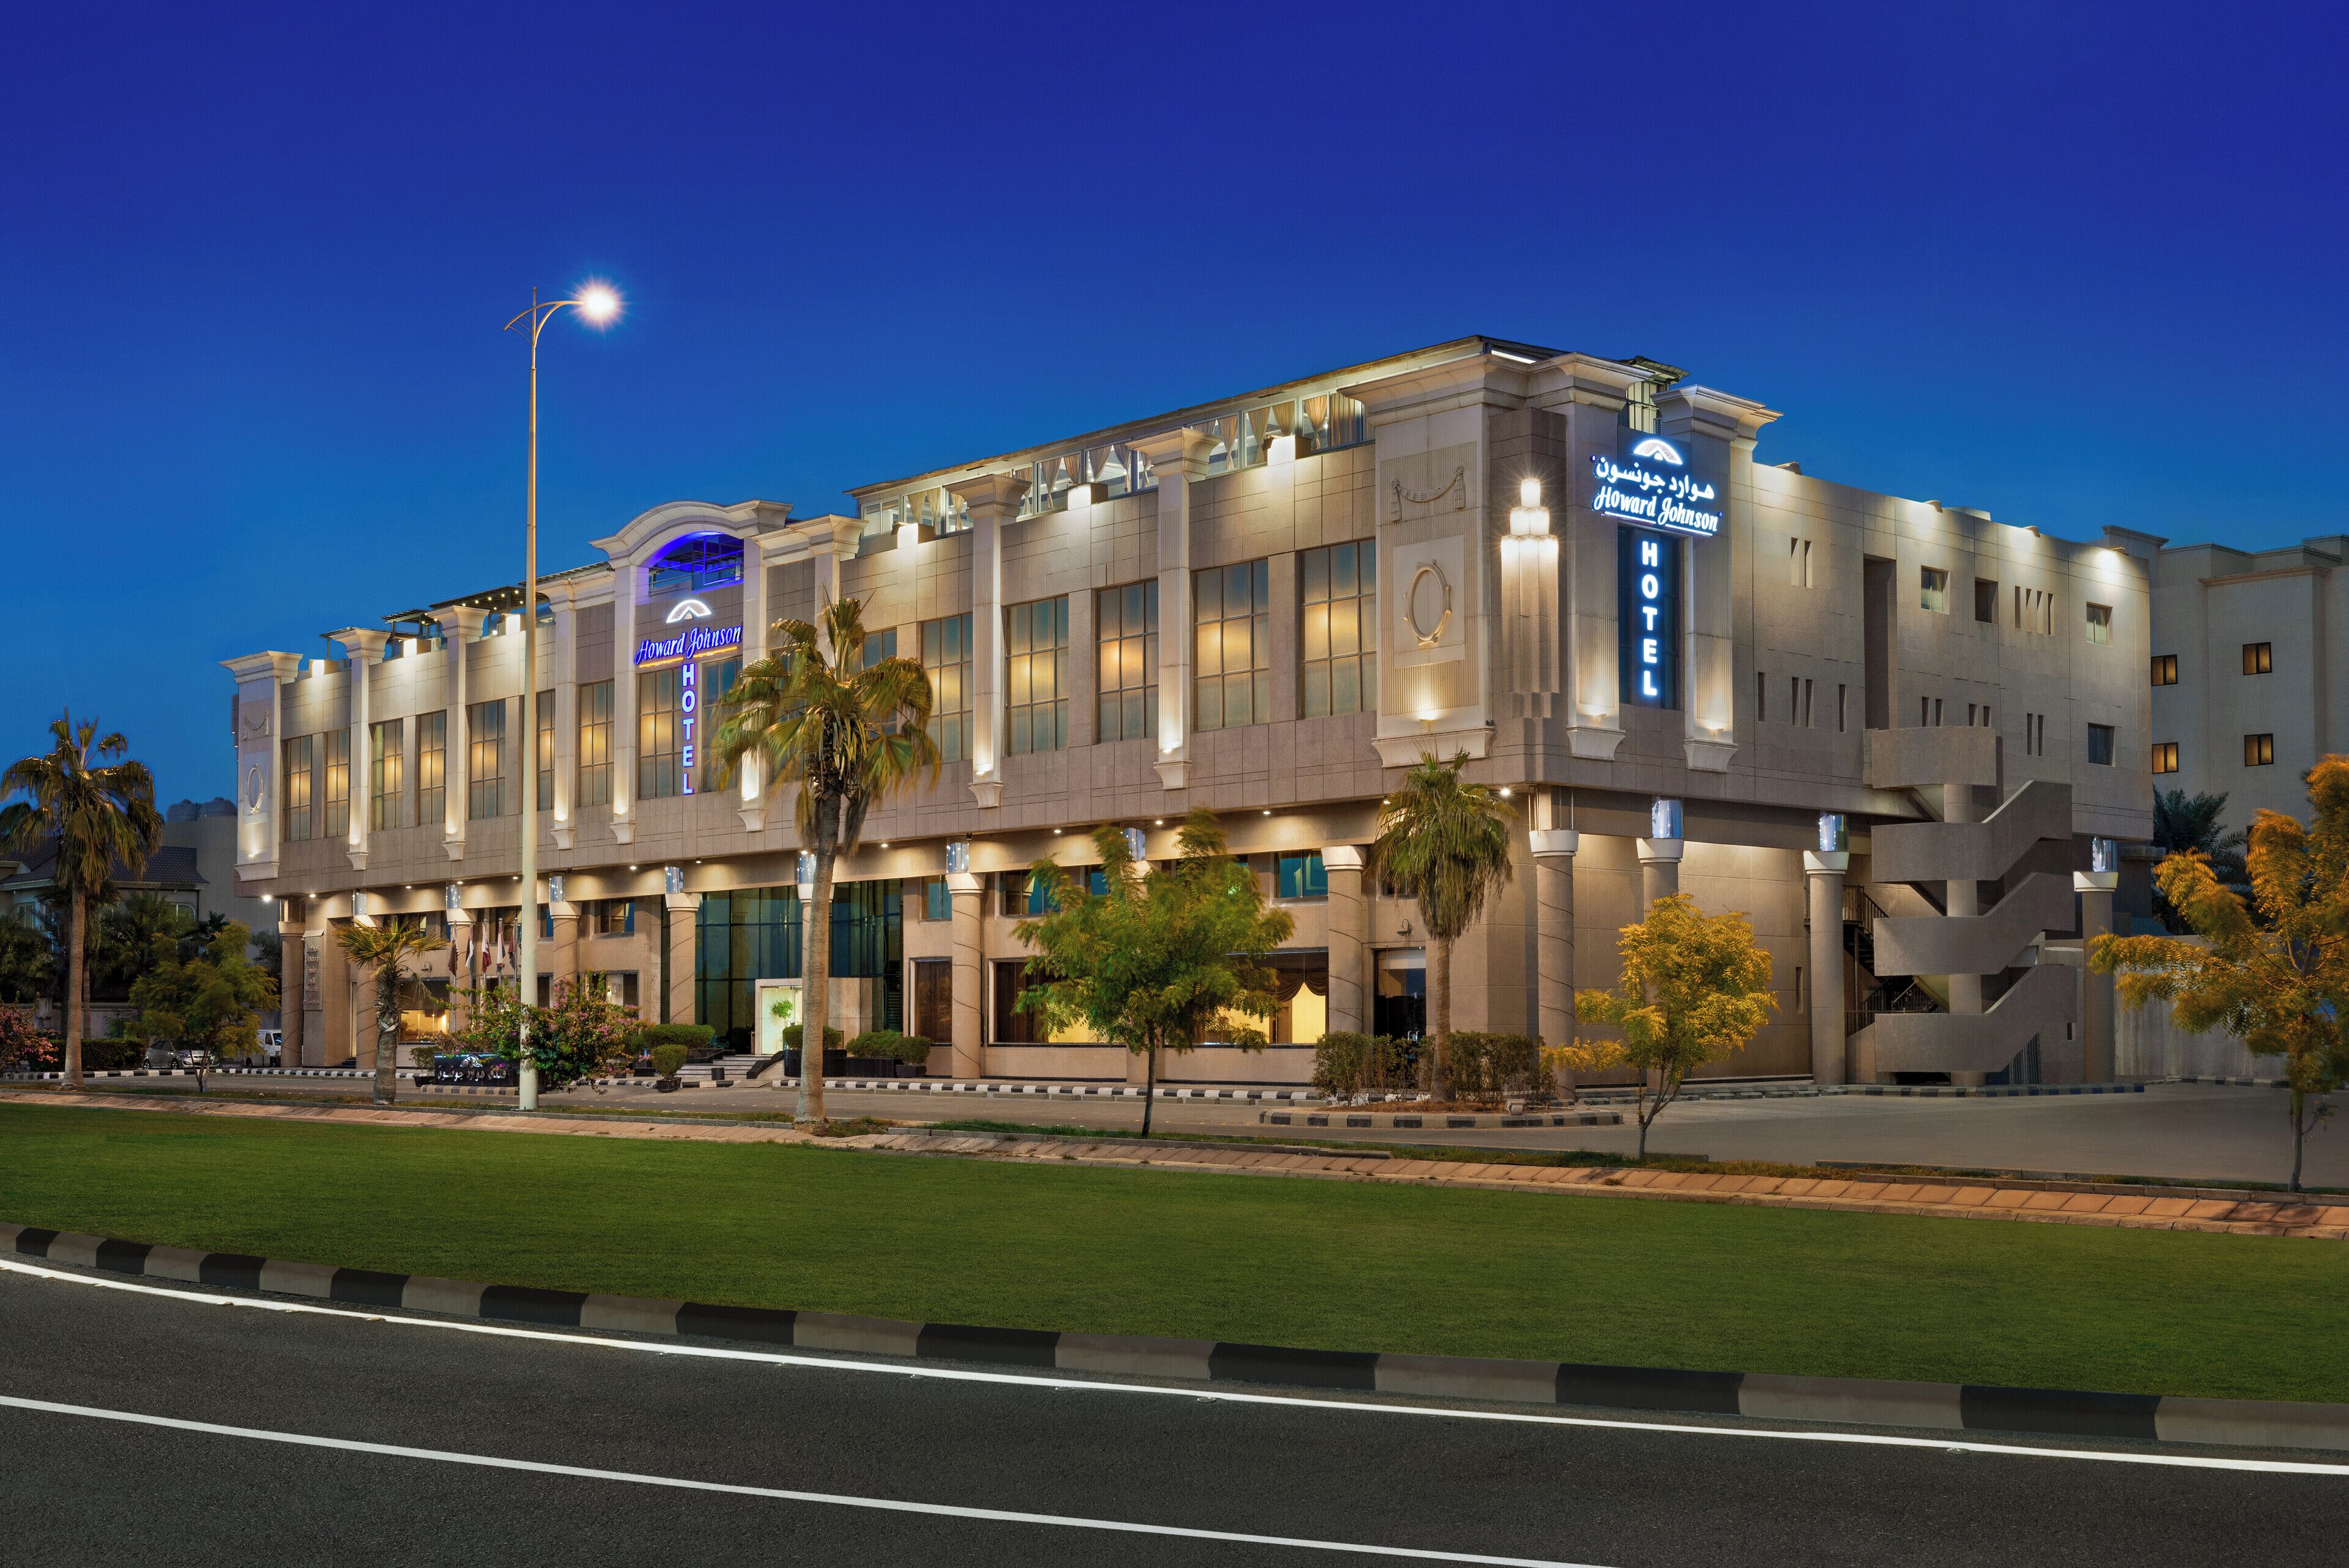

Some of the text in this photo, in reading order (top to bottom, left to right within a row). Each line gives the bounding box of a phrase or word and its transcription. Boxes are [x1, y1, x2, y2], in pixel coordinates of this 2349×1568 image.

[1596, 456, 1714, 502] هوارد جونسون
[1593, 486, 1718, 532] Howard Johnson
[1641, 541, 1658, 696] HOTEL
[634, 626, 743, 665] Howard Johnson
[681, 663, 696, 795] HOTEL
